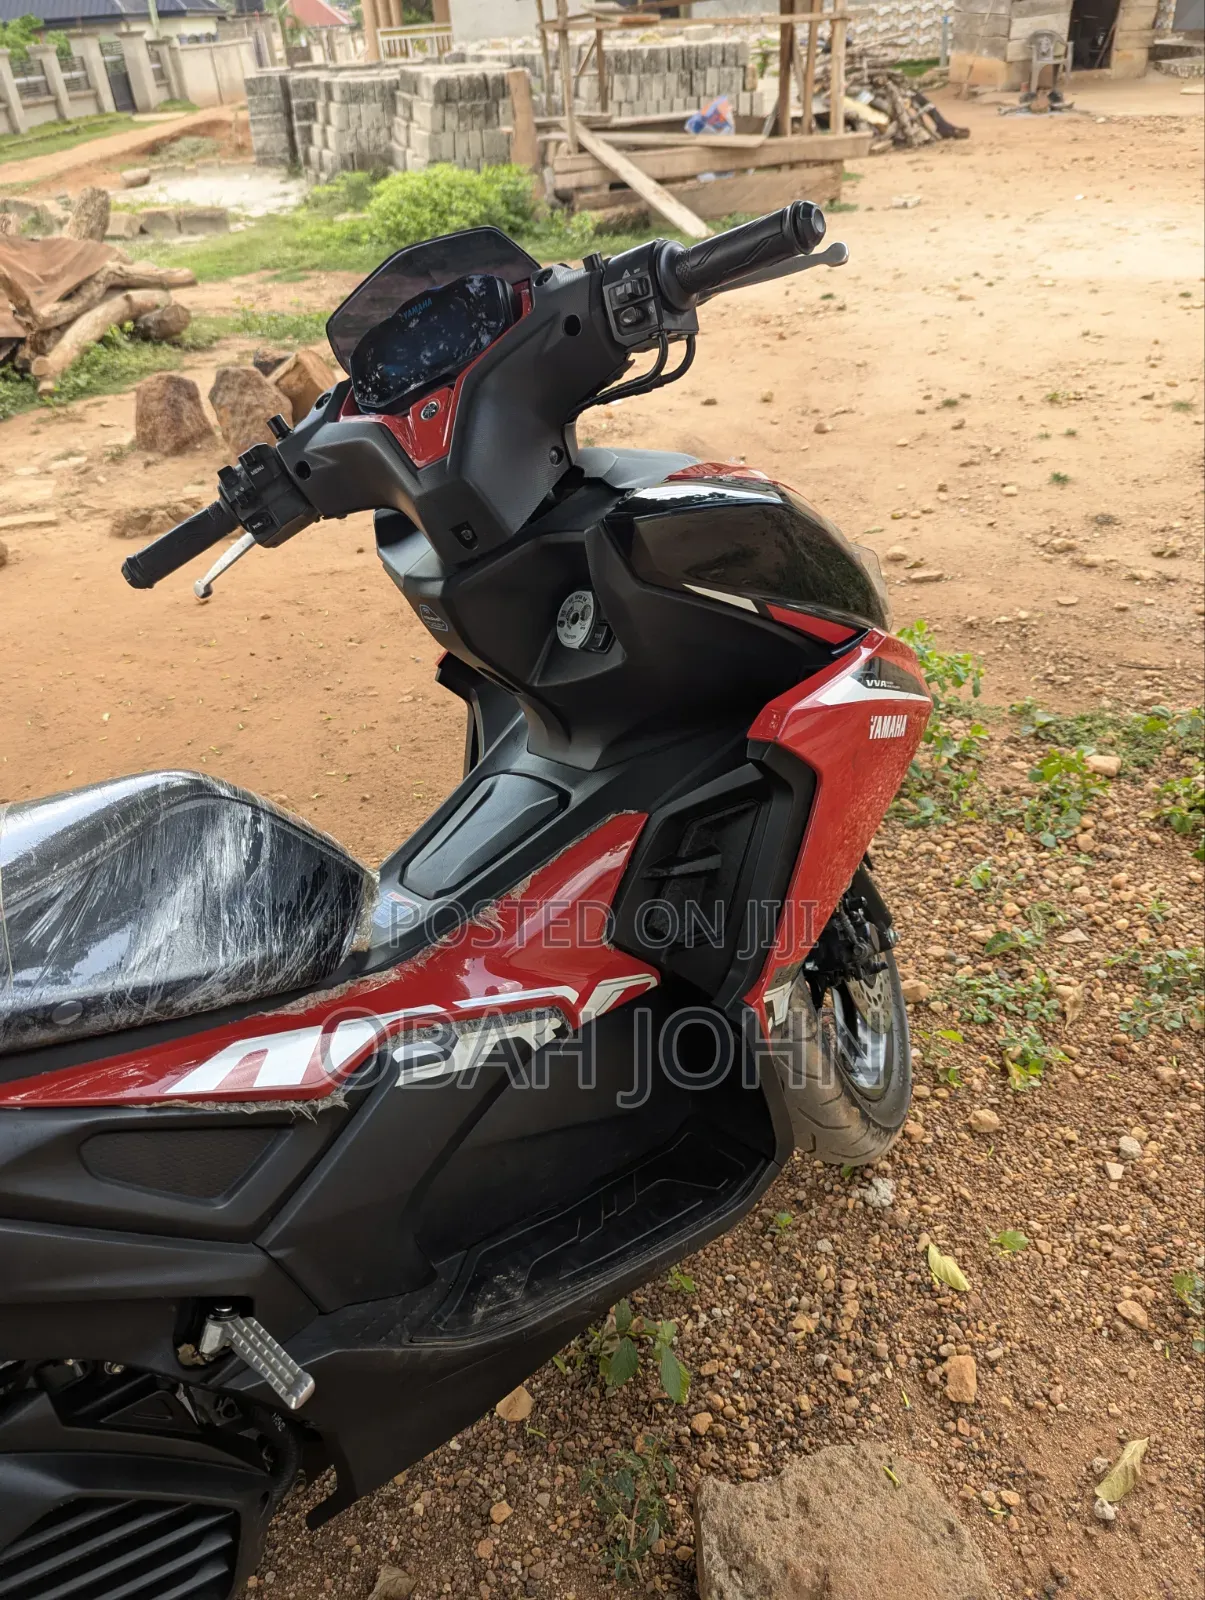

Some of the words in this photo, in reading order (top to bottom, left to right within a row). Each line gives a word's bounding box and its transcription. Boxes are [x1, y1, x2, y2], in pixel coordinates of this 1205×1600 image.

[403, 297, 433, 320] YAMAHA
[866, 679, 887, 688] VVA
[869, 714, 908, 740] YAMAHA
